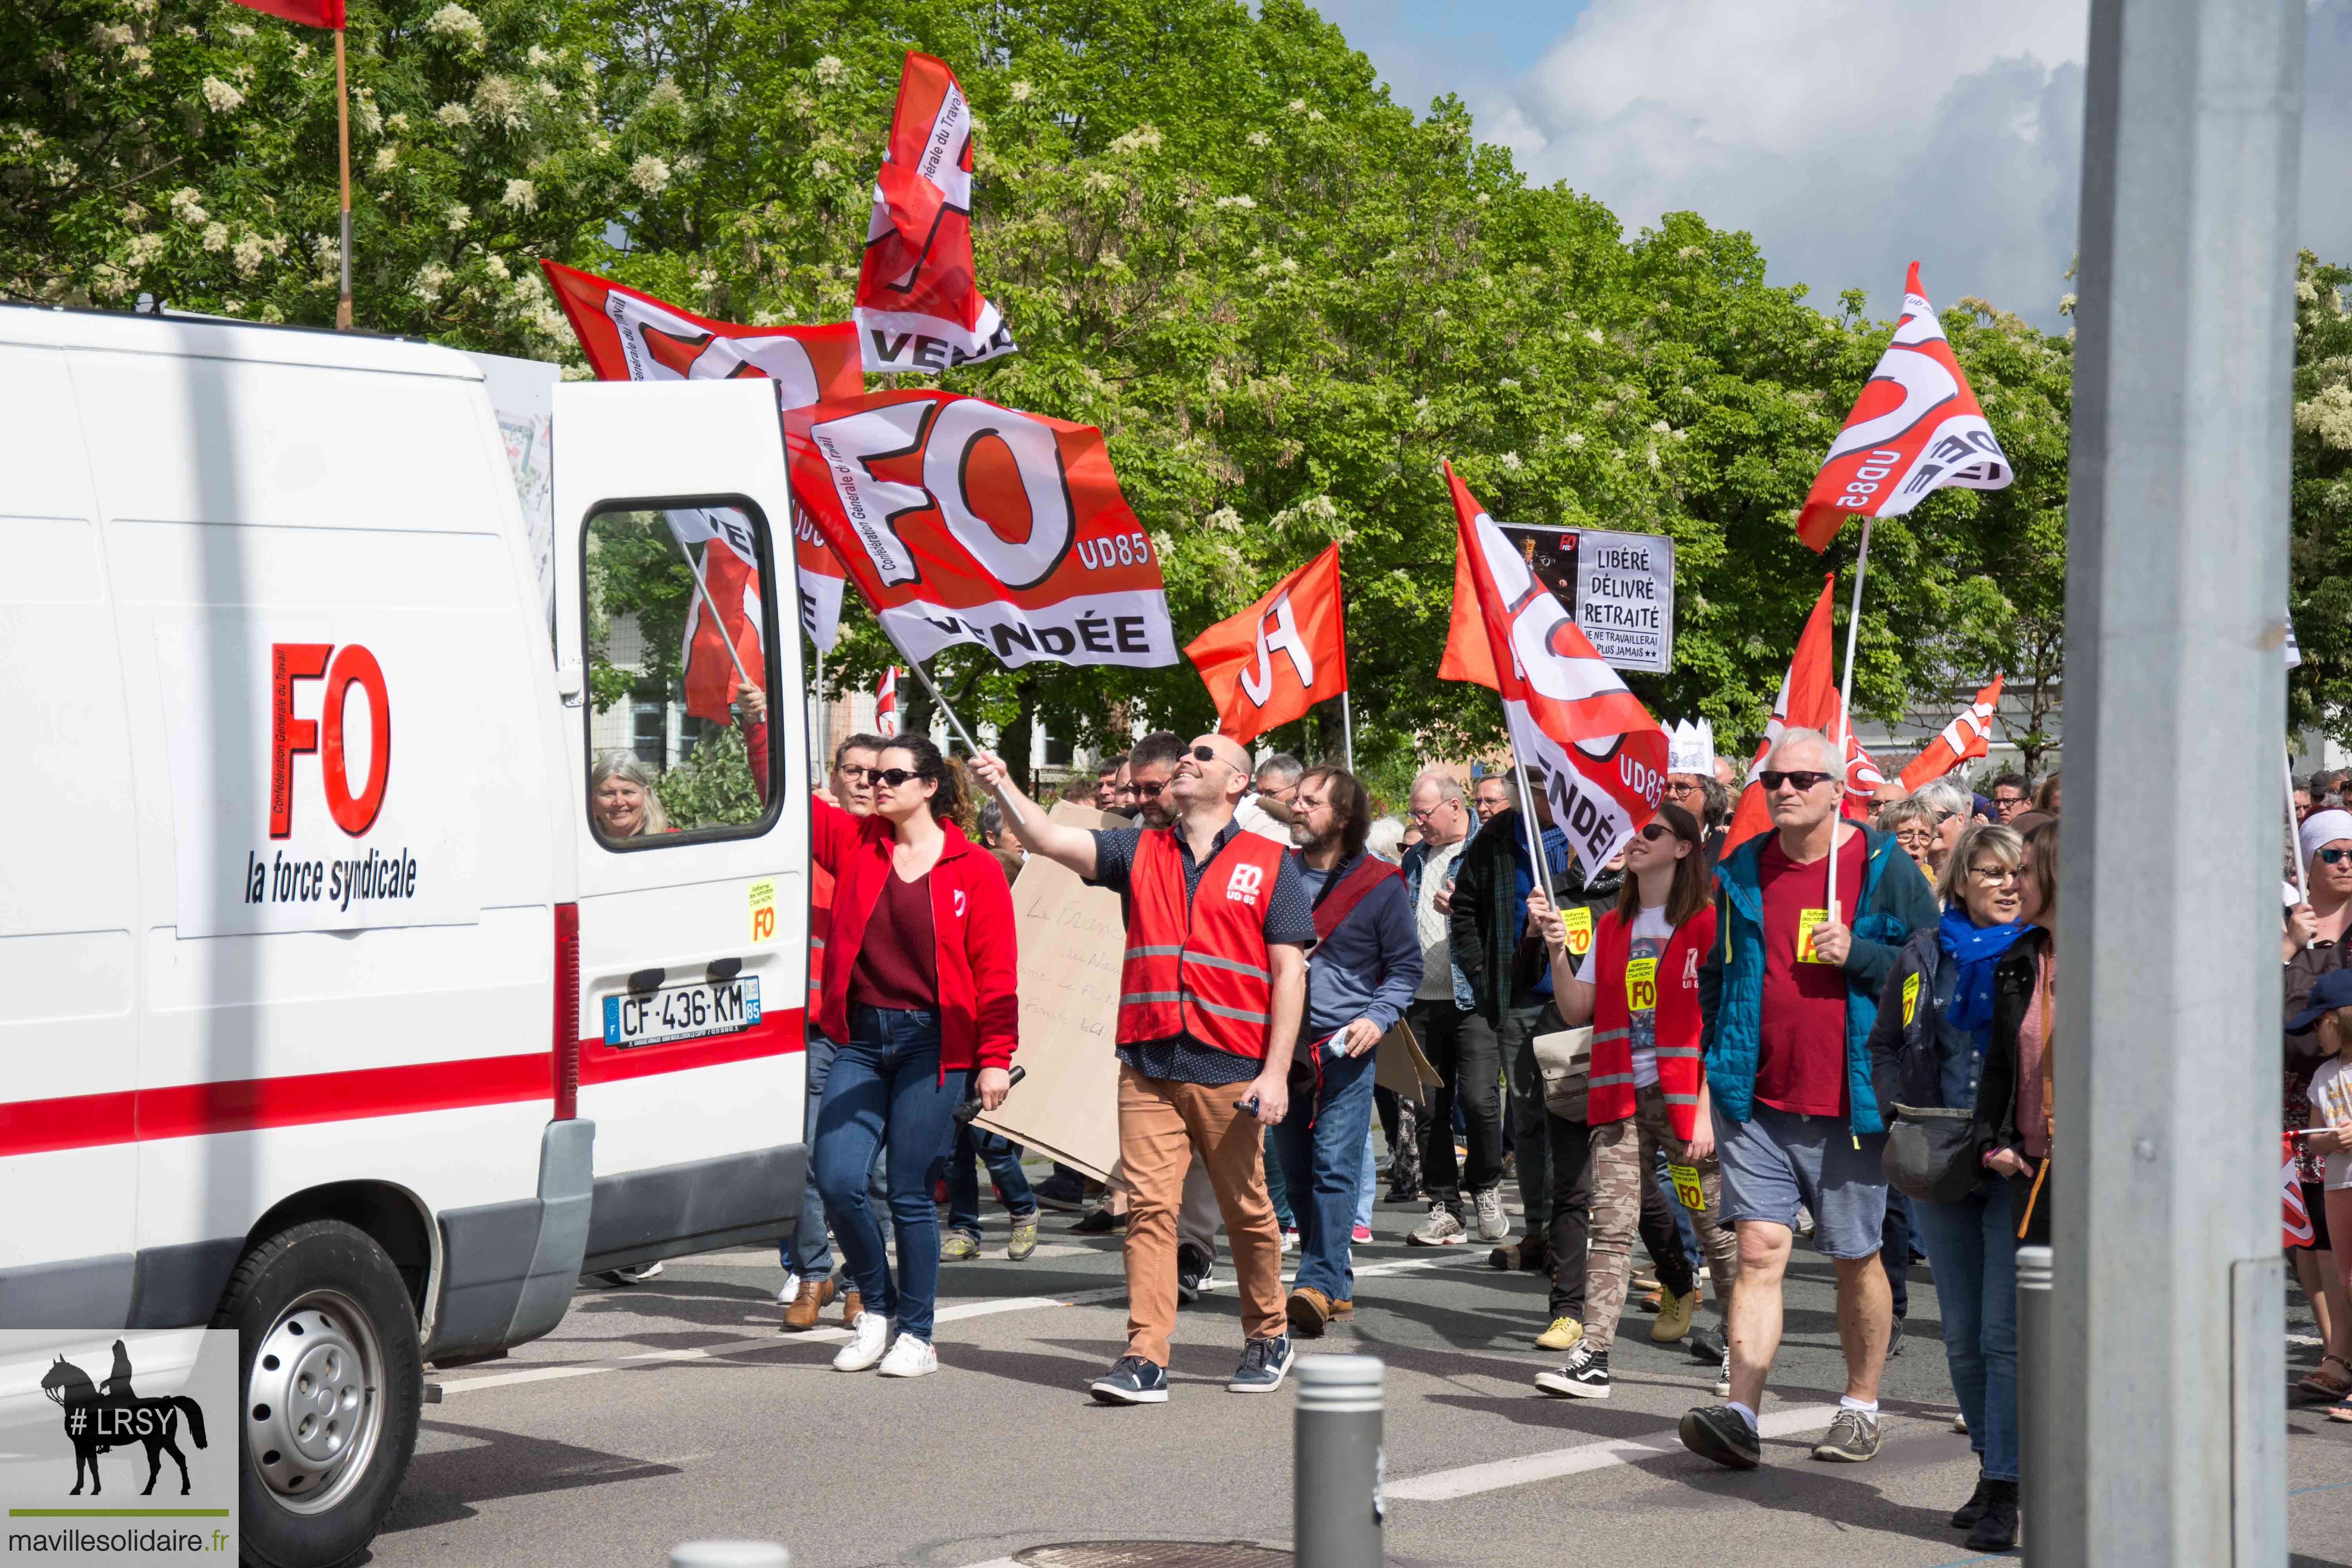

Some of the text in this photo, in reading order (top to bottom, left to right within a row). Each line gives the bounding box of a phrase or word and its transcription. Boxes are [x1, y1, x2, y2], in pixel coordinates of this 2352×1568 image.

[924, 147, 943, 181] nérale
[935, 129, 950, 145] du
[622, 328, 634, 341] du
[810, 398, 1075, 591] FO
[840, 476, 866, 519] Générale
[1076, 532, 1149, 570] UD85
[1559, 534, 1577, 550] FO
[1598, 547, 1650, 571] LIBÉRÉ
[1592, 573, 1654, 599] DÉLIVRÉ
[1584, 603, 1659, 628] RETRAITÉ
[1594, 631, 1604, 641] NE
[1606, 632, 1657, 646] TRAVAILLERAI
[1597, 644, 1644, 657] PLUS JAMAIS
[269, 643, 391, 841] FO
[274, 650, 286, 813] Confédération Générale du Travail
[1619, 753, 1665, 809] UD85
[245, 847, 417, 912] la force syndicale
[1227, 864, 1262, 891] FO
[760, 895, 771, 903] NON
[1026, 897, 1051, 920] La
[1227, 890, 1242, 900] UD
[1243, 895, 1255, 906] 85
[753, 906, 774, 941] FO
[1567, 928, 1589, 951] FO
[1802, 933, 1816, 961] F
[1632, 980, 1654, 1008] FO
[610, 1025, 615, 1036] F
[746, 1003, 760, 1020] 85
[1678, 1183, 1700, 1207] FO
